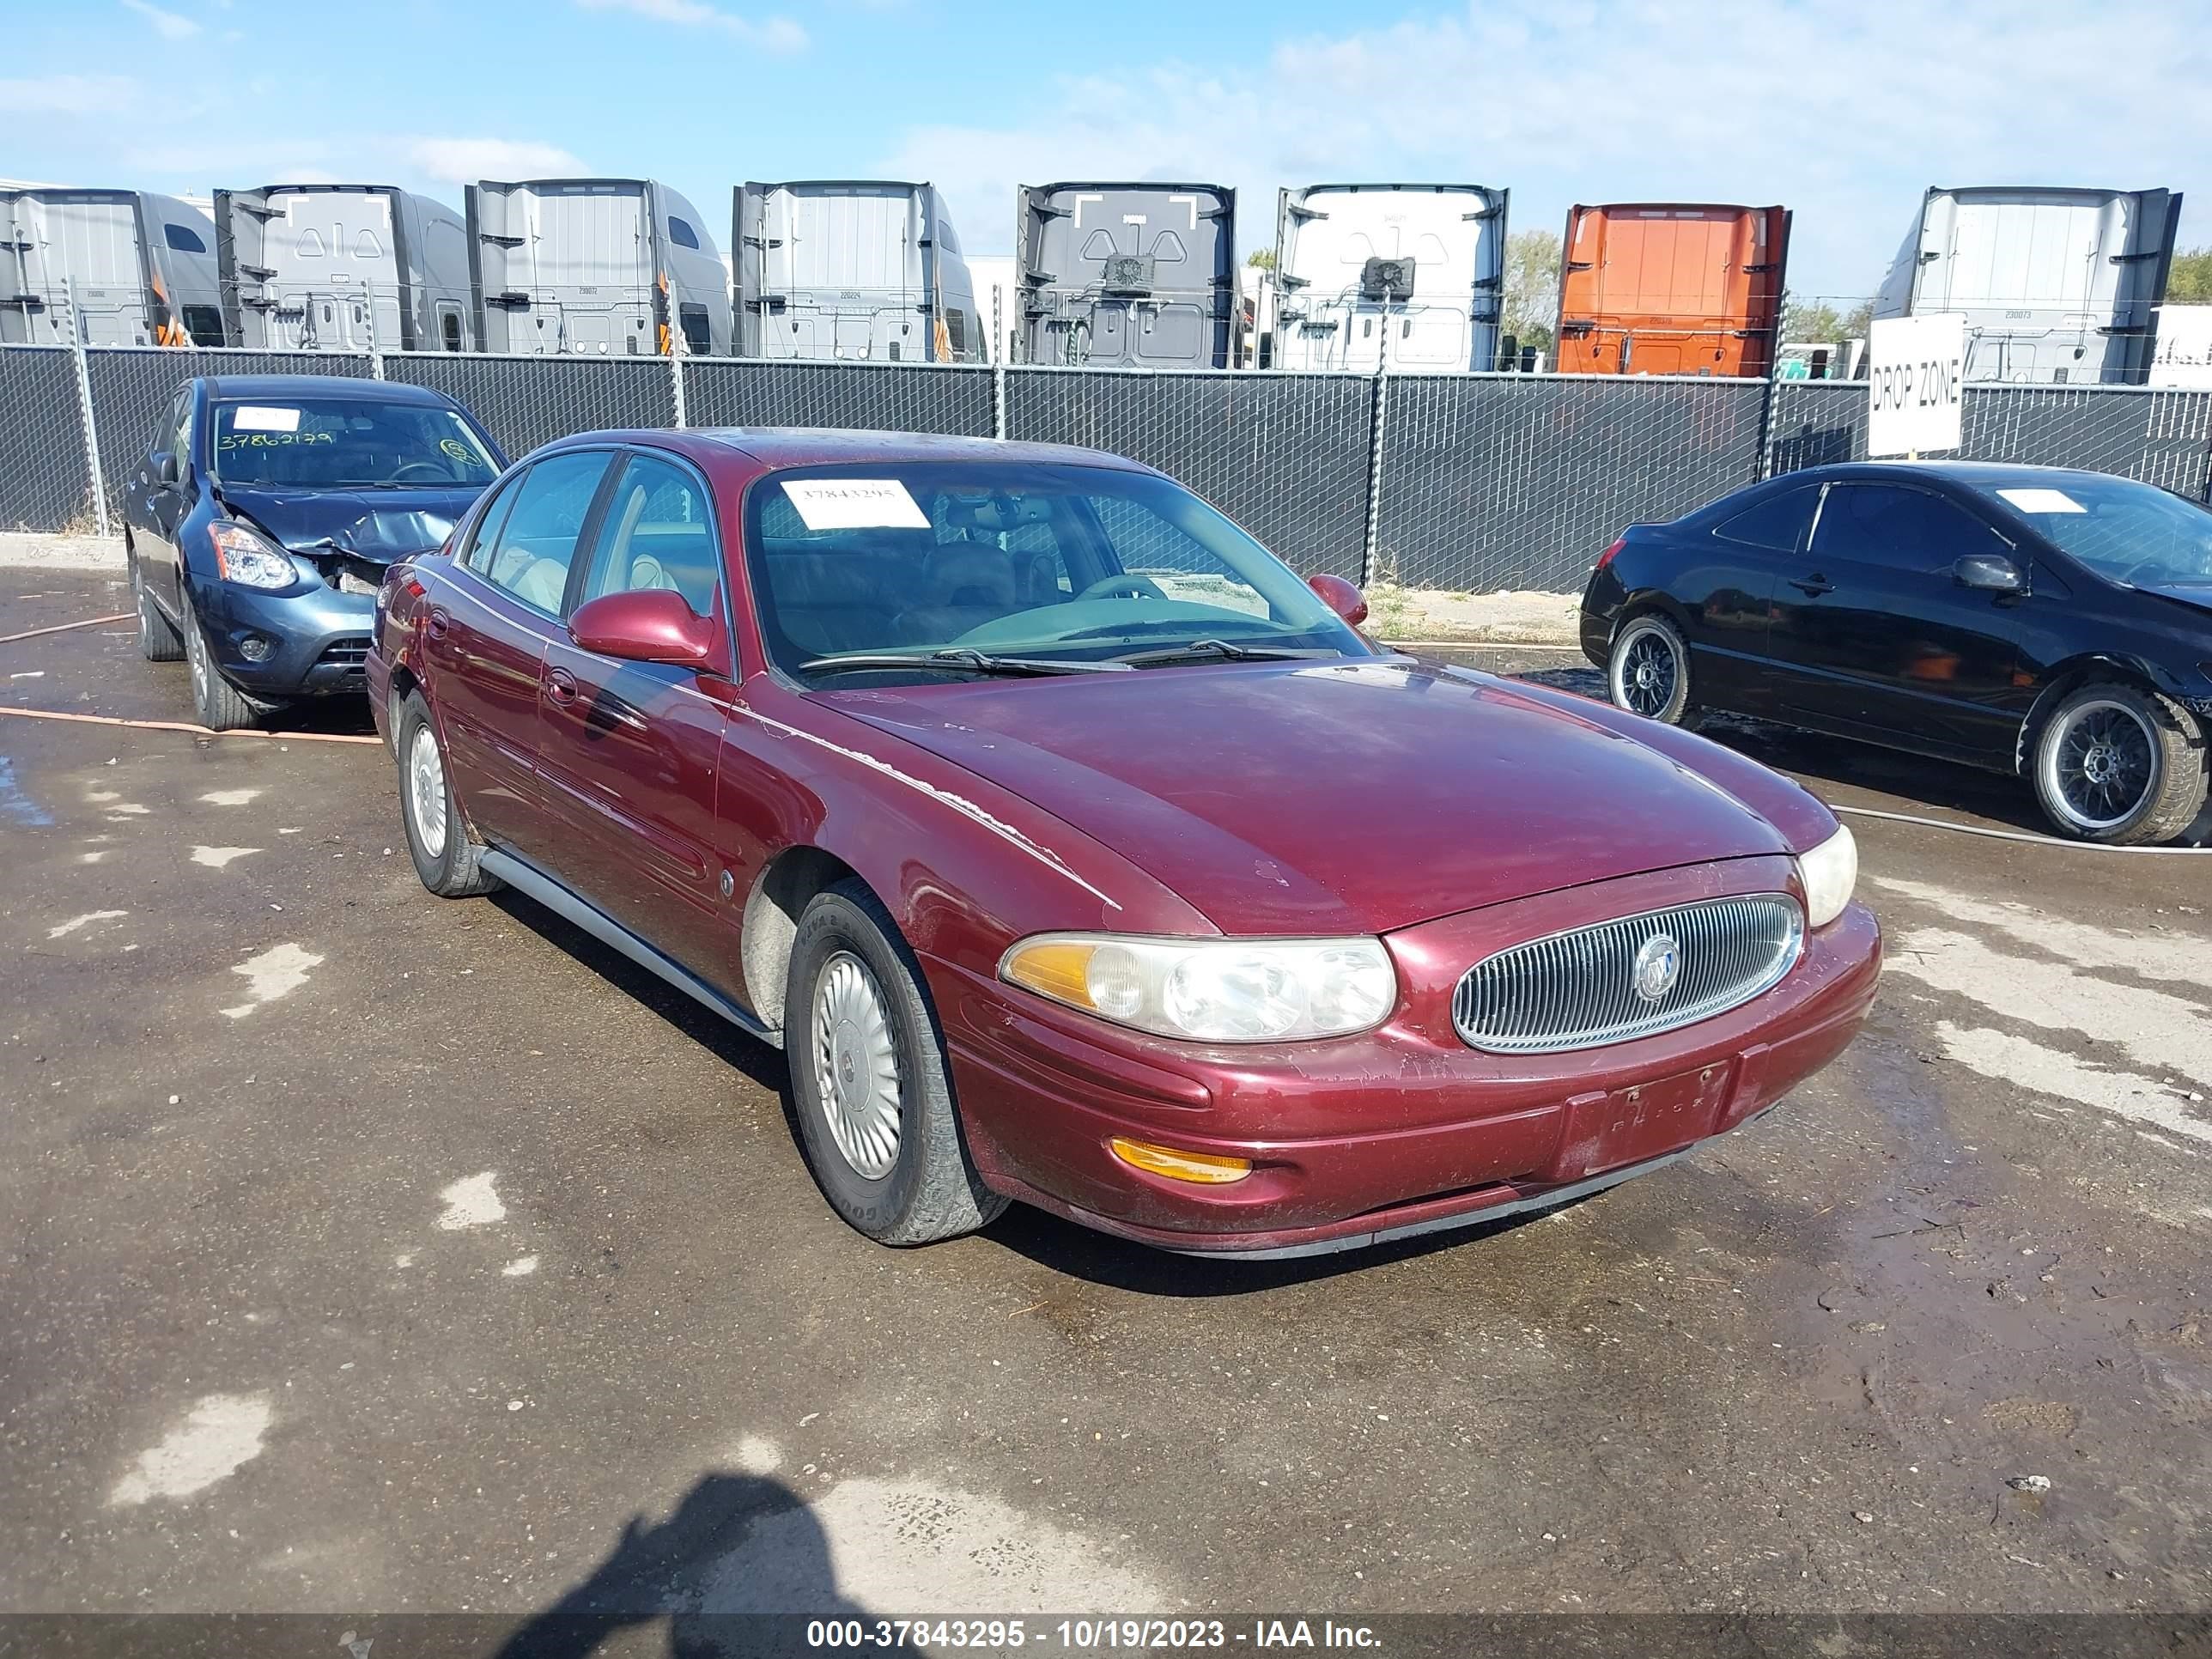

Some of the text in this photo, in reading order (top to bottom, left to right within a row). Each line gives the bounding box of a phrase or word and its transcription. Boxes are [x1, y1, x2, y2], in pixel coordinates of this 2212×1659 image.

[2005, 310, 2032, 319] 230073
[1873, 359, 1959, 411] DROP ZONE
[219, 433, 333, 450] 37862179
